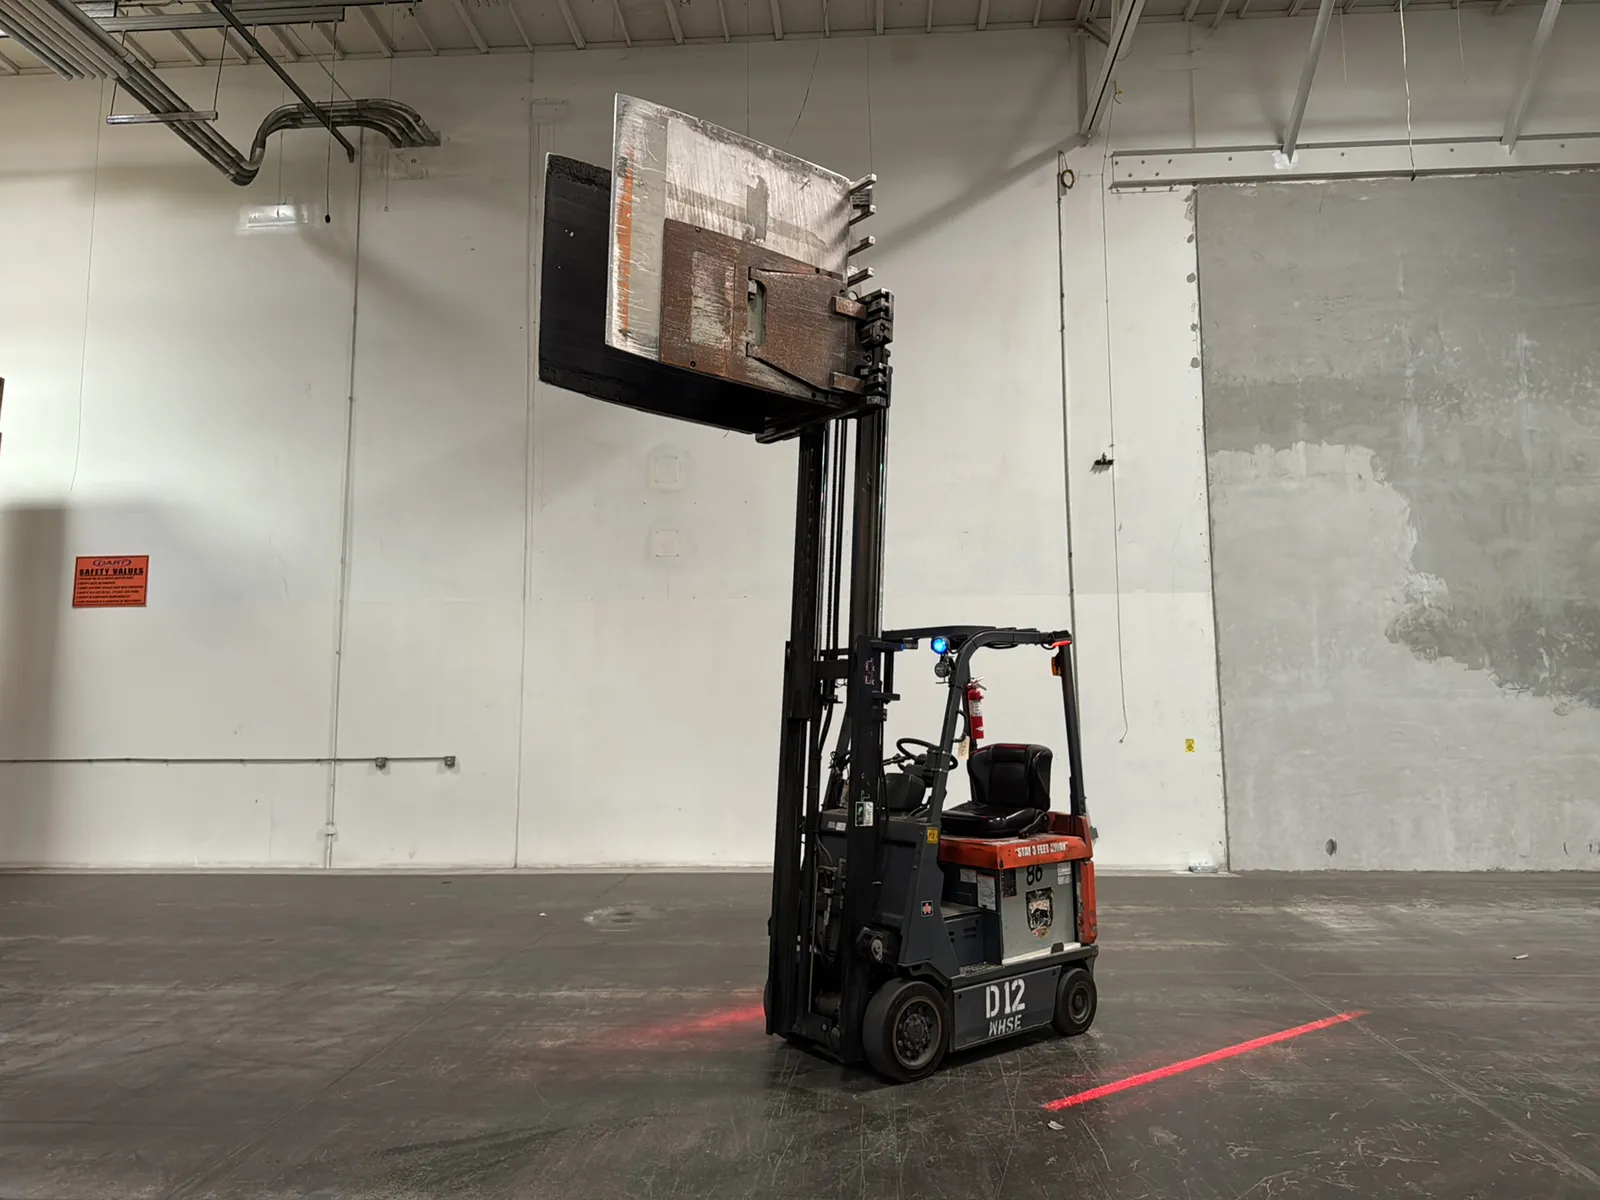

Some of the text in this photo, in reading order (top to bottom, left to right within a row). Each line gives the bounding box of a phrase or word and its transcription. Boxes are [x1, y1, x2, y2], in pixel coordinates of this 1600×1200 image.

[79, 567, 144, 576] SAFETY VALUES
[1037, 844, 1050, 855] FEET
[1026, 864, 1043, 886] 86
